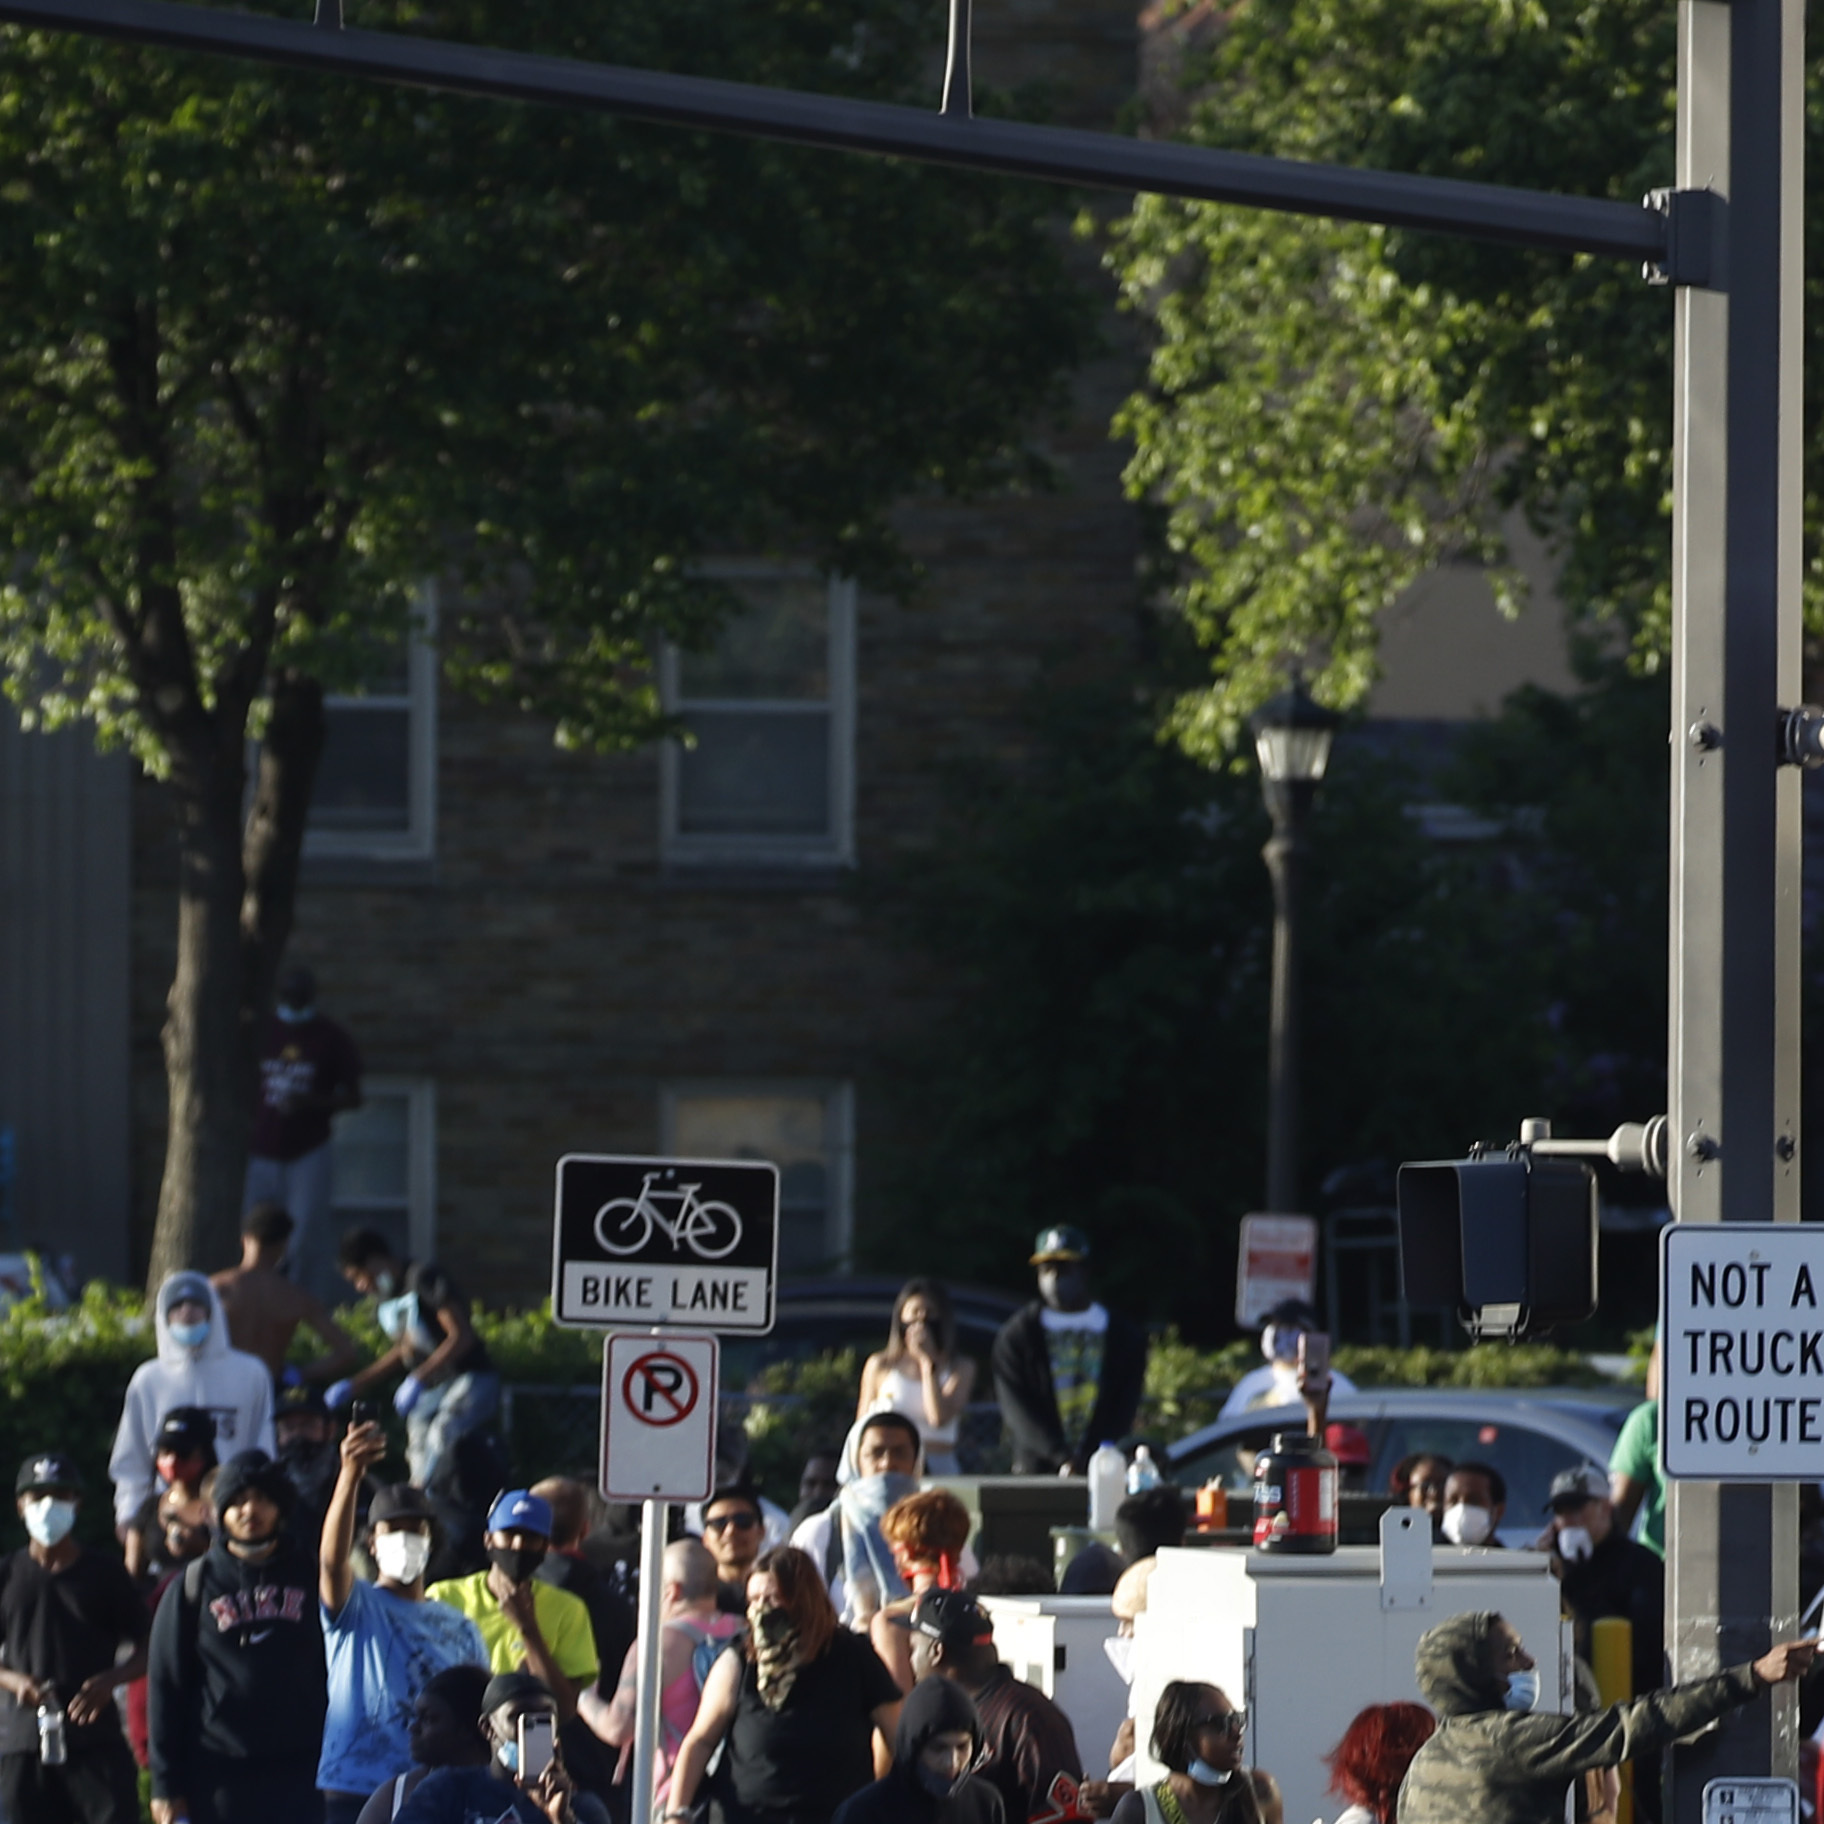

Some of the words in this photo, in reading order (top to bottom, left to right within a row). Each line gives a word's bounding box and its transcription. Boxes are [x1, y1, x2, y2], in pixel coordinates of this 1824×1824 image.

[582, 1275, 653, 1309] BIKE
[671, 1279, 748, 1312] LANE
[1691, 1261, 1771, 1309] NOT
[1791, 1262, 1817, 1309] A
[1683, 1330, 1824, 1376] TRUCK
[1685, 1398, 1822, 1444] ROUTE
[209, 1584, 305, 1633] NIKE
